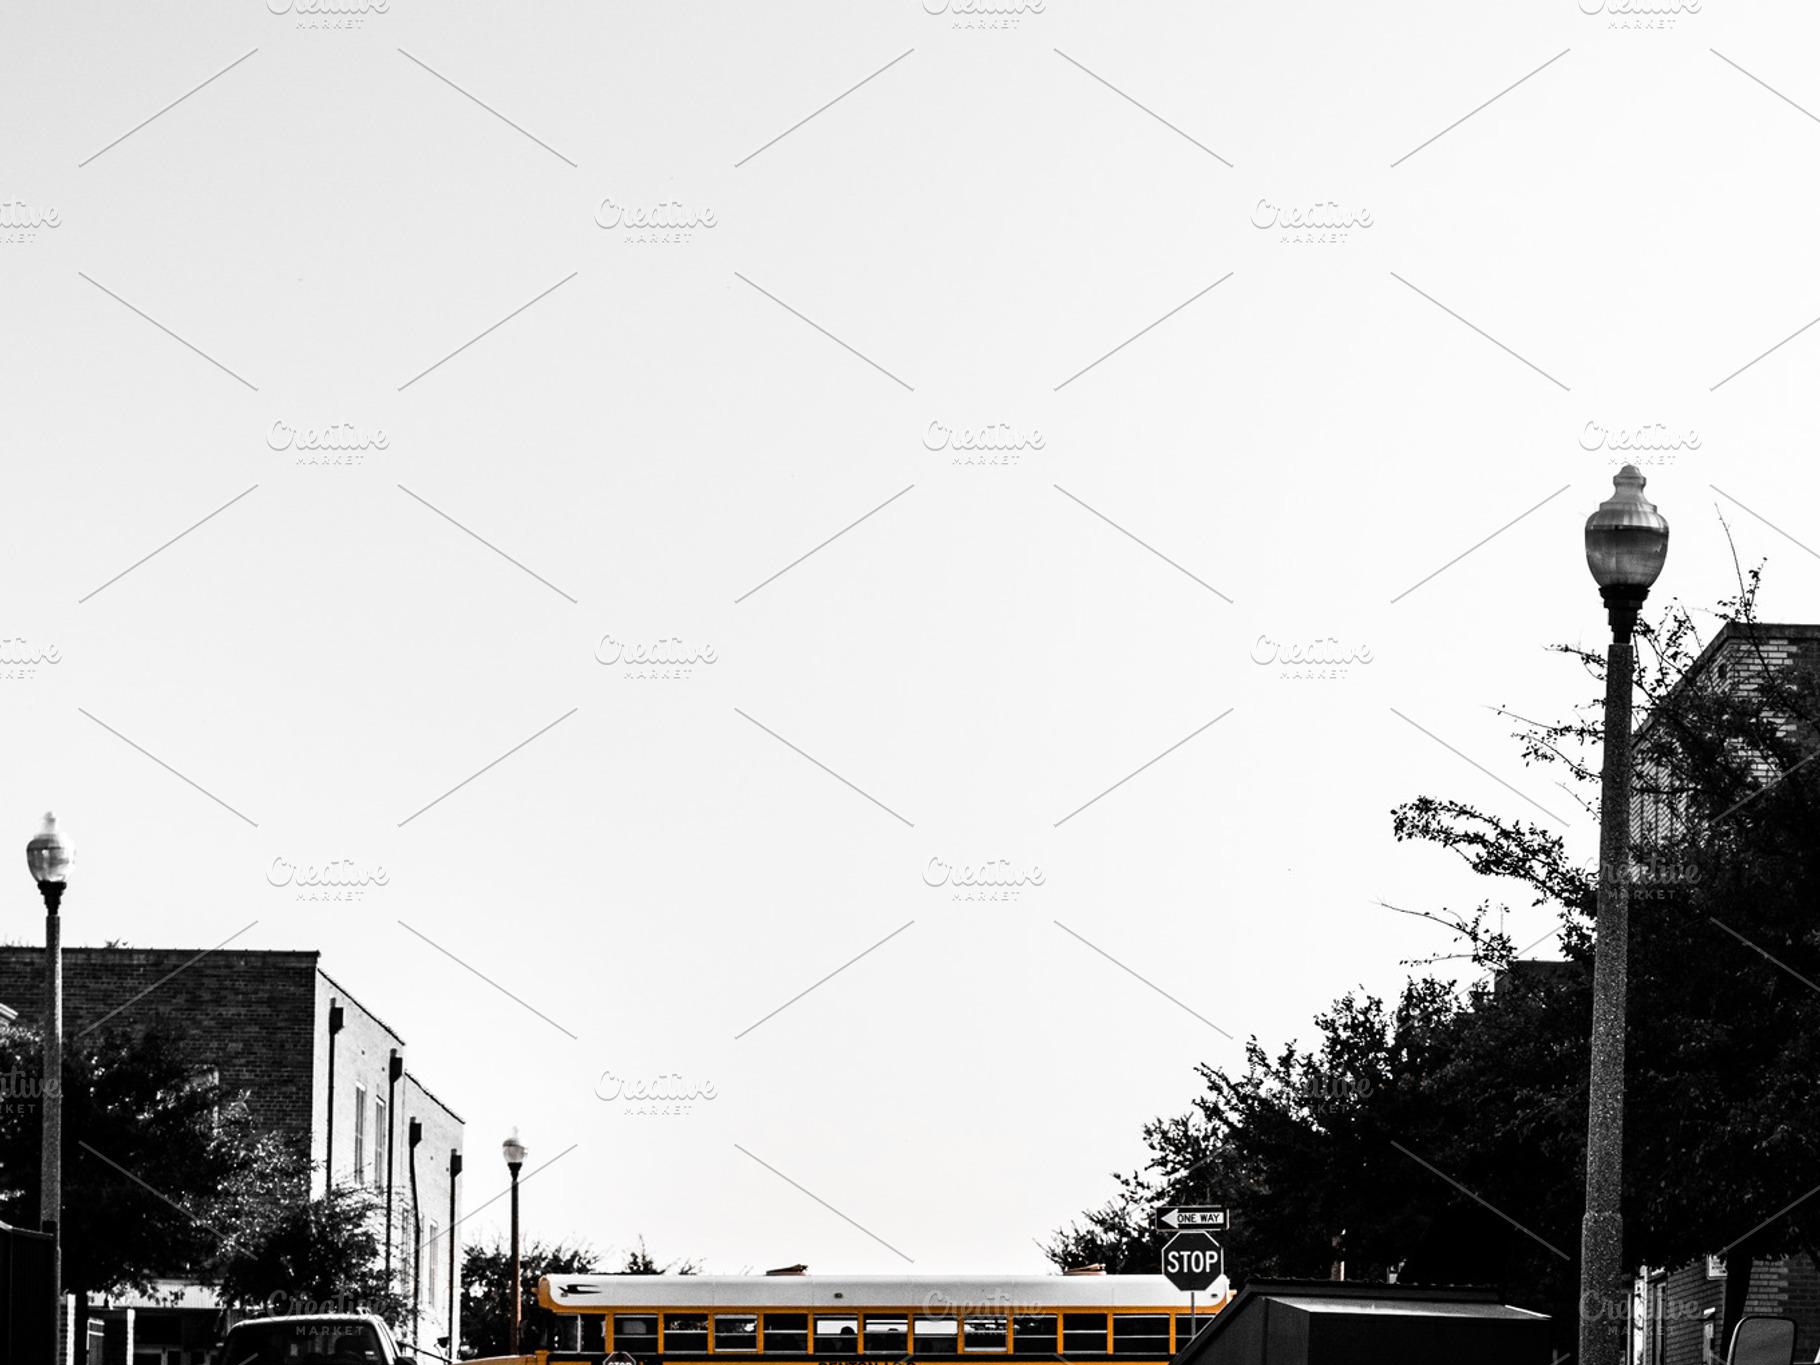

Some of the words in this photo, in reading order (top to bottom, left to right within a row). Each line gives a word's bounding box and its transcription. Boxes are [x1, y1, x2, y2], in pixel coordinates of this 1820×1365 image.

[1177, 1213, 1197, 1223] ONE
[1200, 1213, 1220, 1223] WAY
[1167, 1250, 1218, 1273] STOP
